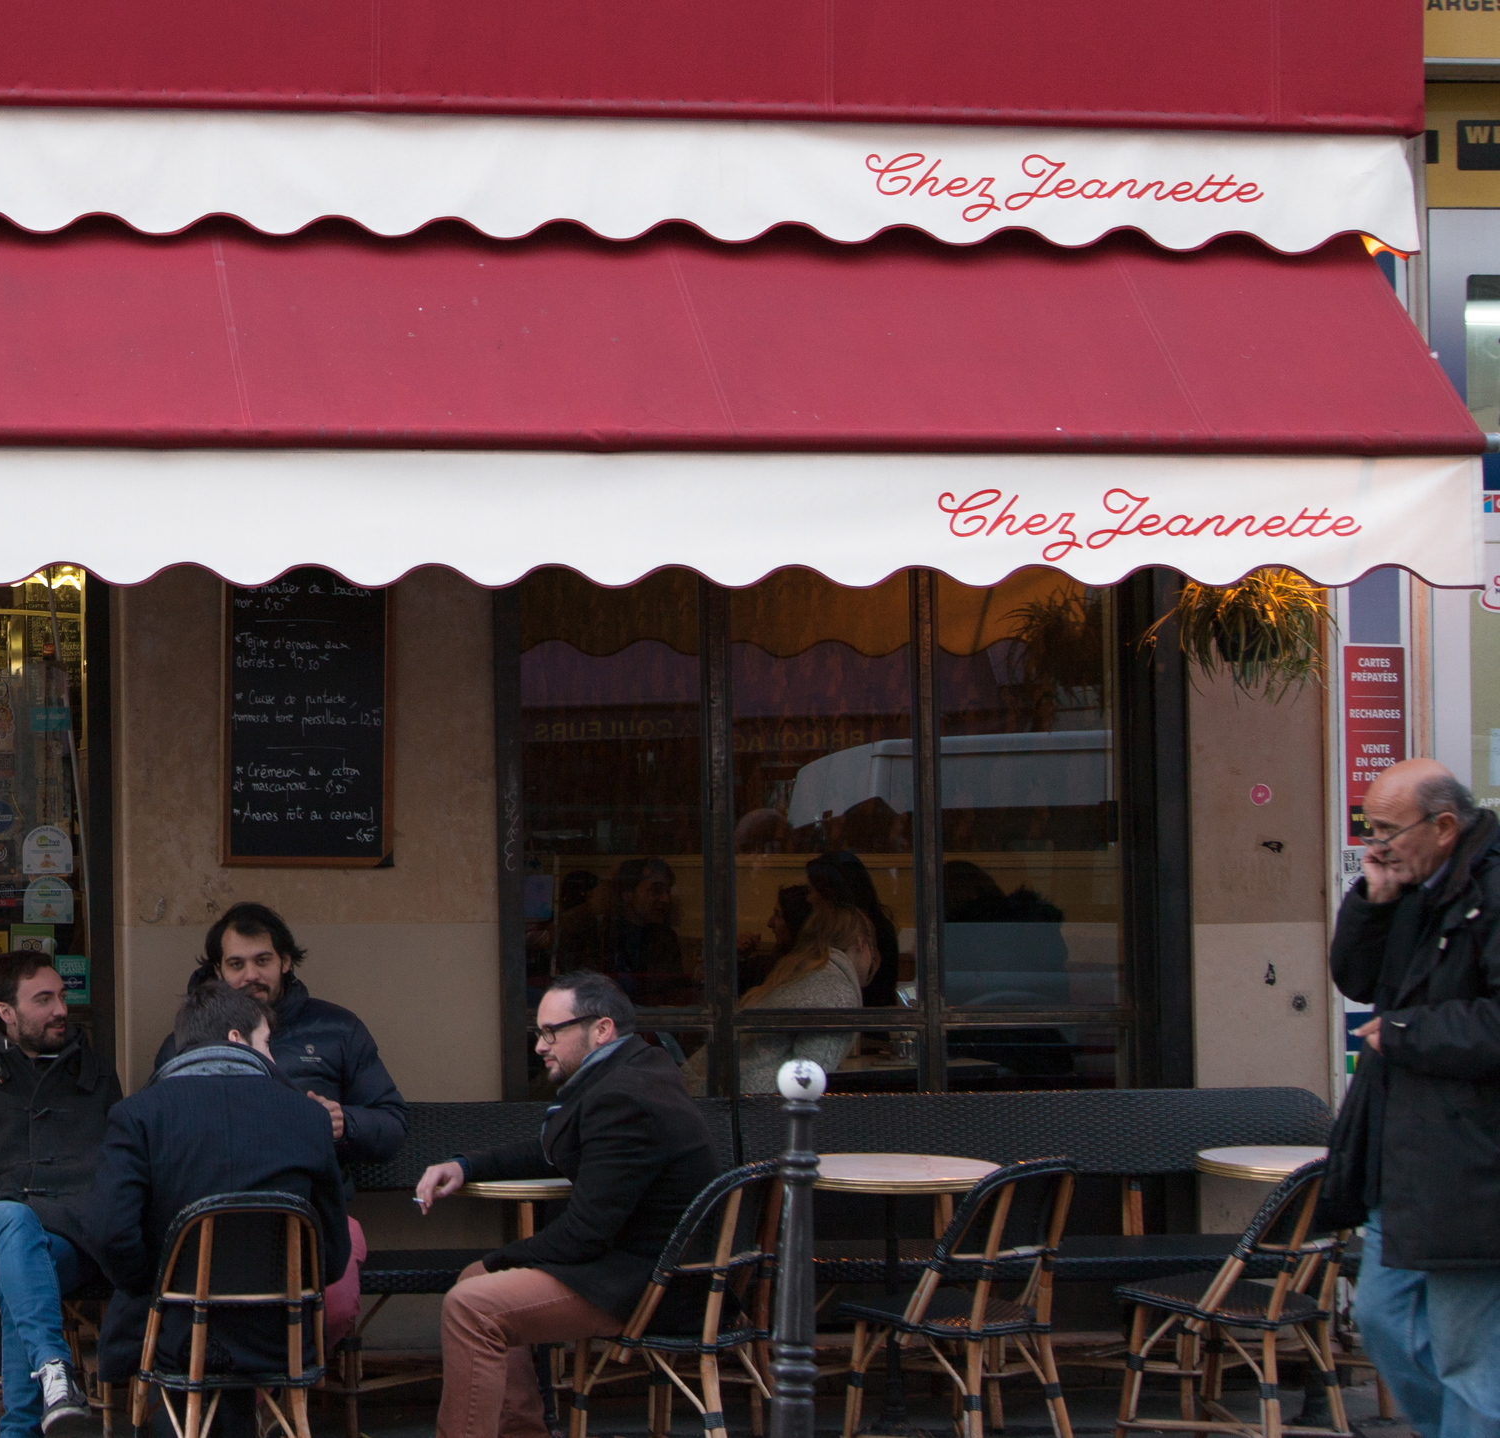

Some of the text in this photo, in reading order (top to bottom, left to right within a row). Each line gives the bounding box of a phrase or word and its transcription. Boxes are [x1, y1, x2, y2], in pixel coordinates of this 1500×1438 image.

[866, 153, 1264, 222] Chez Jeannette
[938, 488, 1361, 561] Chez Jeannette
[1358, 658, 1390, 668] CARTES
[1351, 669, 1398, 682] PRÉPAYÉES
[1349, 709, 1401, 719] RECHARGES
[1362, 744, 1391, 754] VENTE
[1355, 757, 1396, 767] EN GROS
[1352, 769, 1381, 781] ET DÉT
